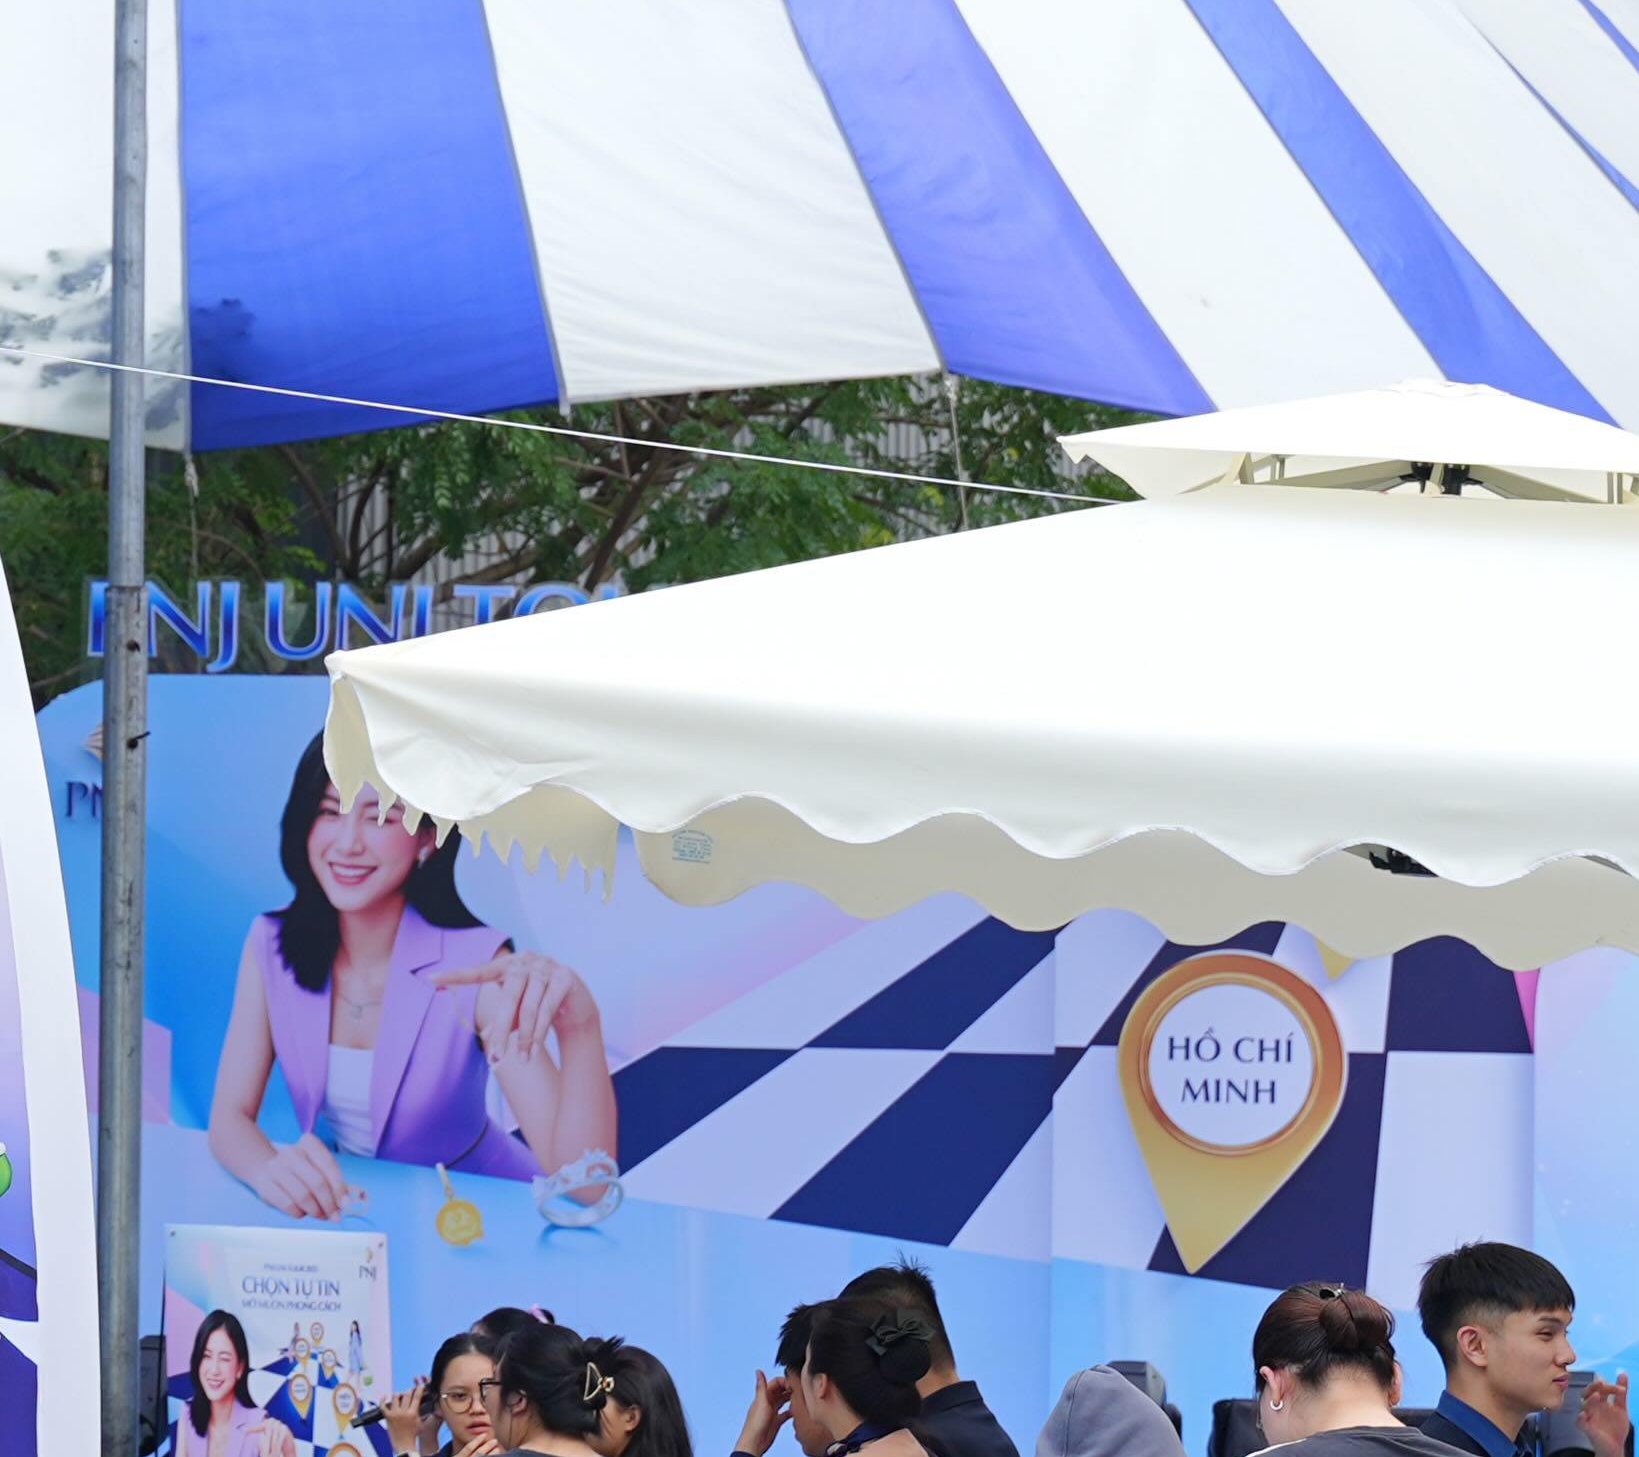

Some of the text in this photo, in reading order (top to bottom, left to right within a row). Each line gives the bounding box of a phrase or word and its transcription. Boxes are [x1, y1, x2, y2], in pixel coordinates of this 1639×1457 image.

[263, 578, 435, 662] UNI
[1167, 1026, 1294, 1063] HỒ CHÍ
[1180, 1078, 1276, 1104] MINH
